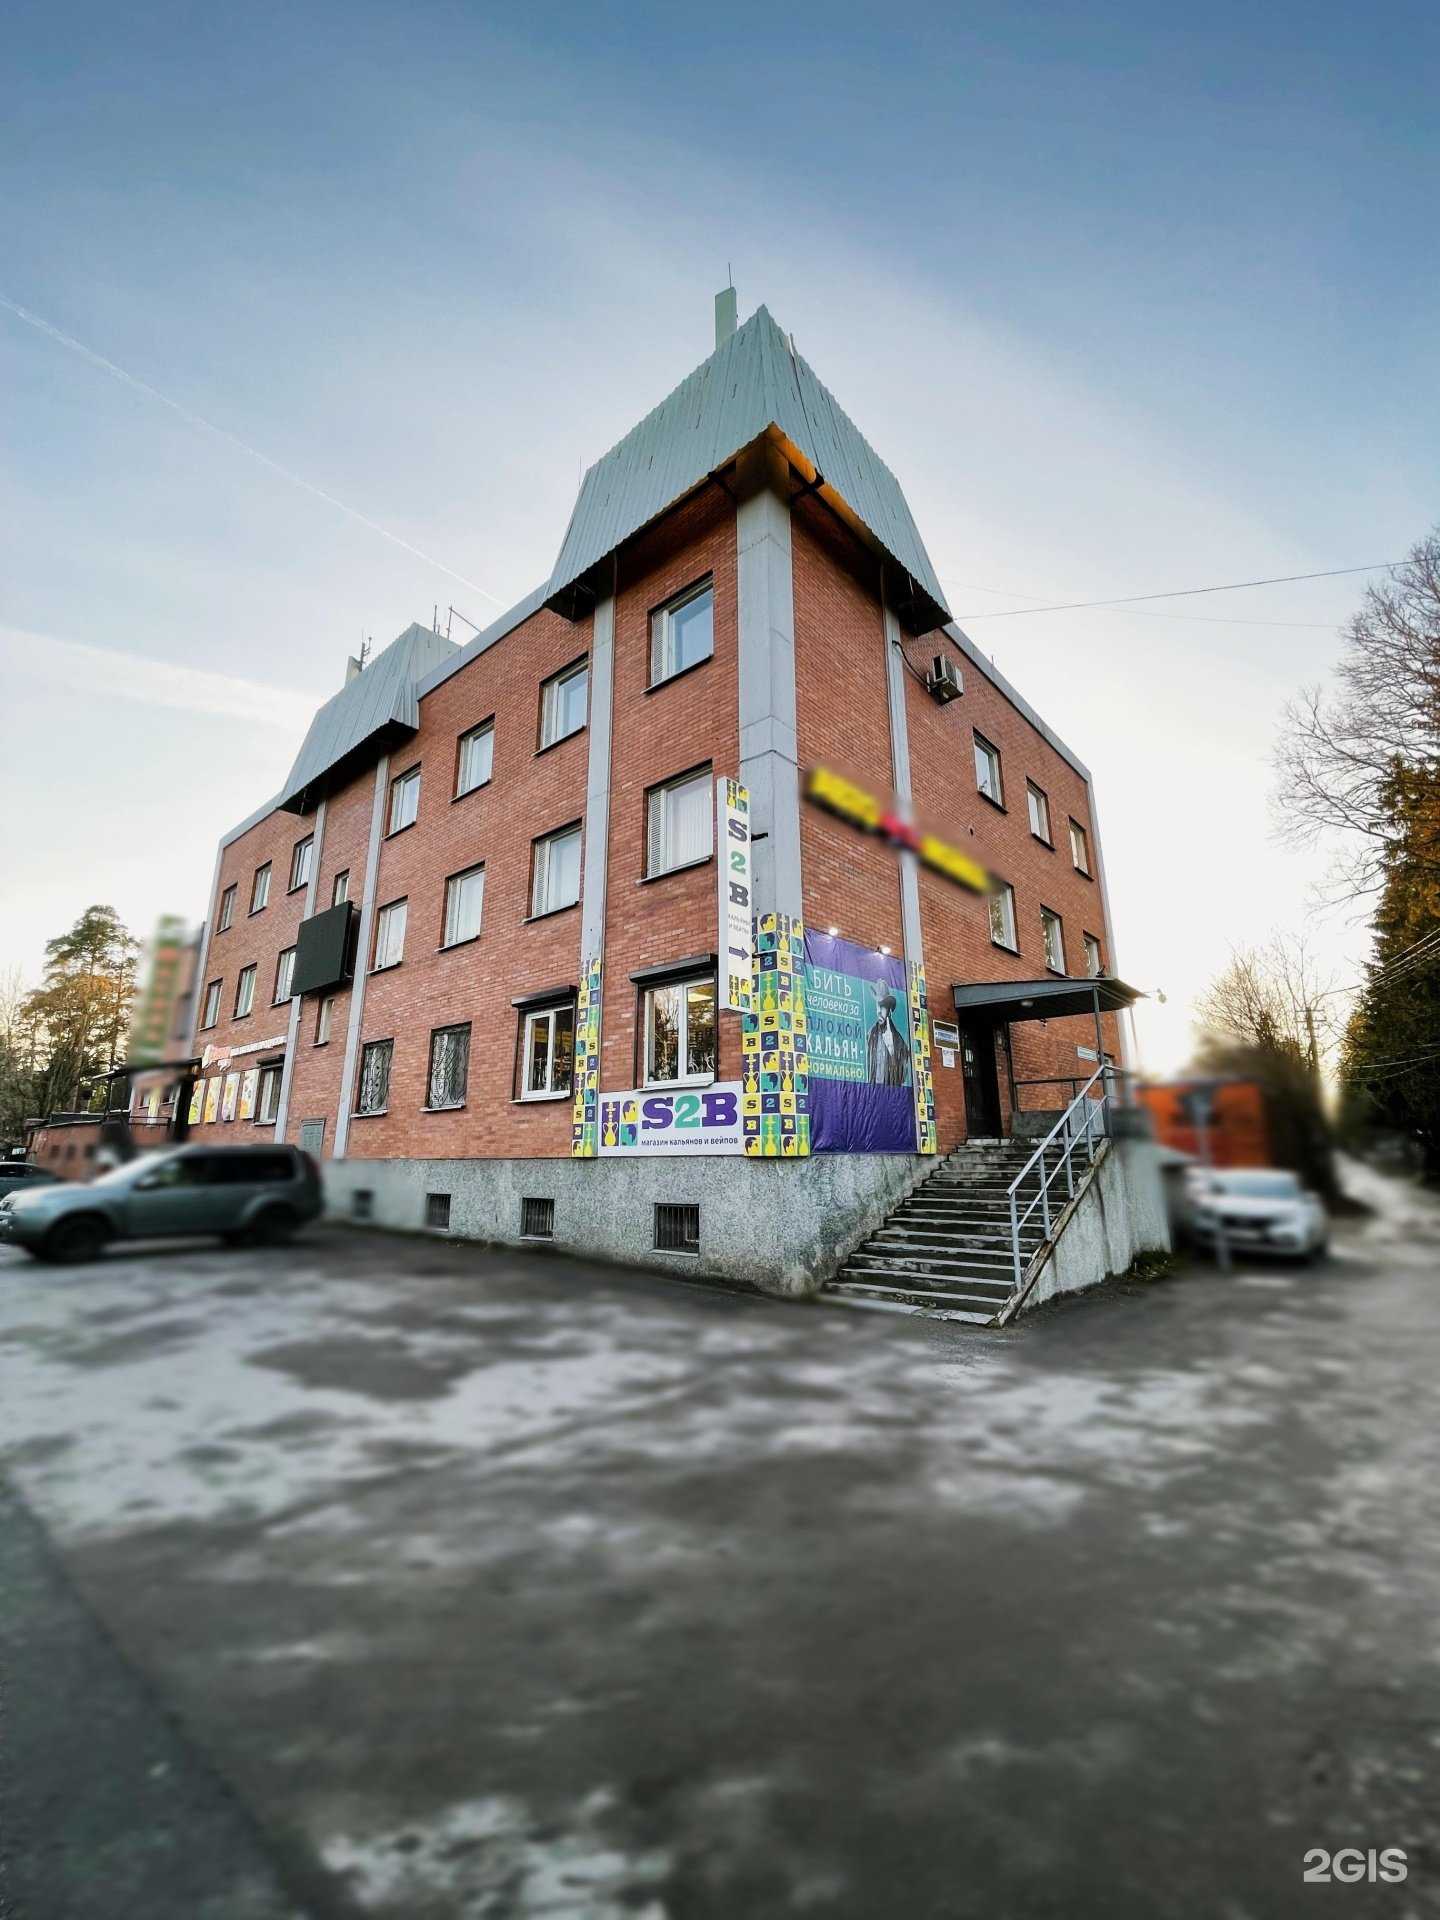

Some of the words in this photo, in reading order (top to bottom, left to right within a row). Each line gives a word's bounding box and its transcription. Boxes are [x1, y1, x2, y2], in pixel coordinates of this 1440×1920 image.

[813, 969, 851, 997] БИТЬ
[807, 993, 848, 1013] человека
[849, 1004, 860, 1016] за
[641, 1092, 738, 1130] S2B
[669, 1138, 703, 1147] кальянов
[710, 1136, 738, 1145] вейпов
